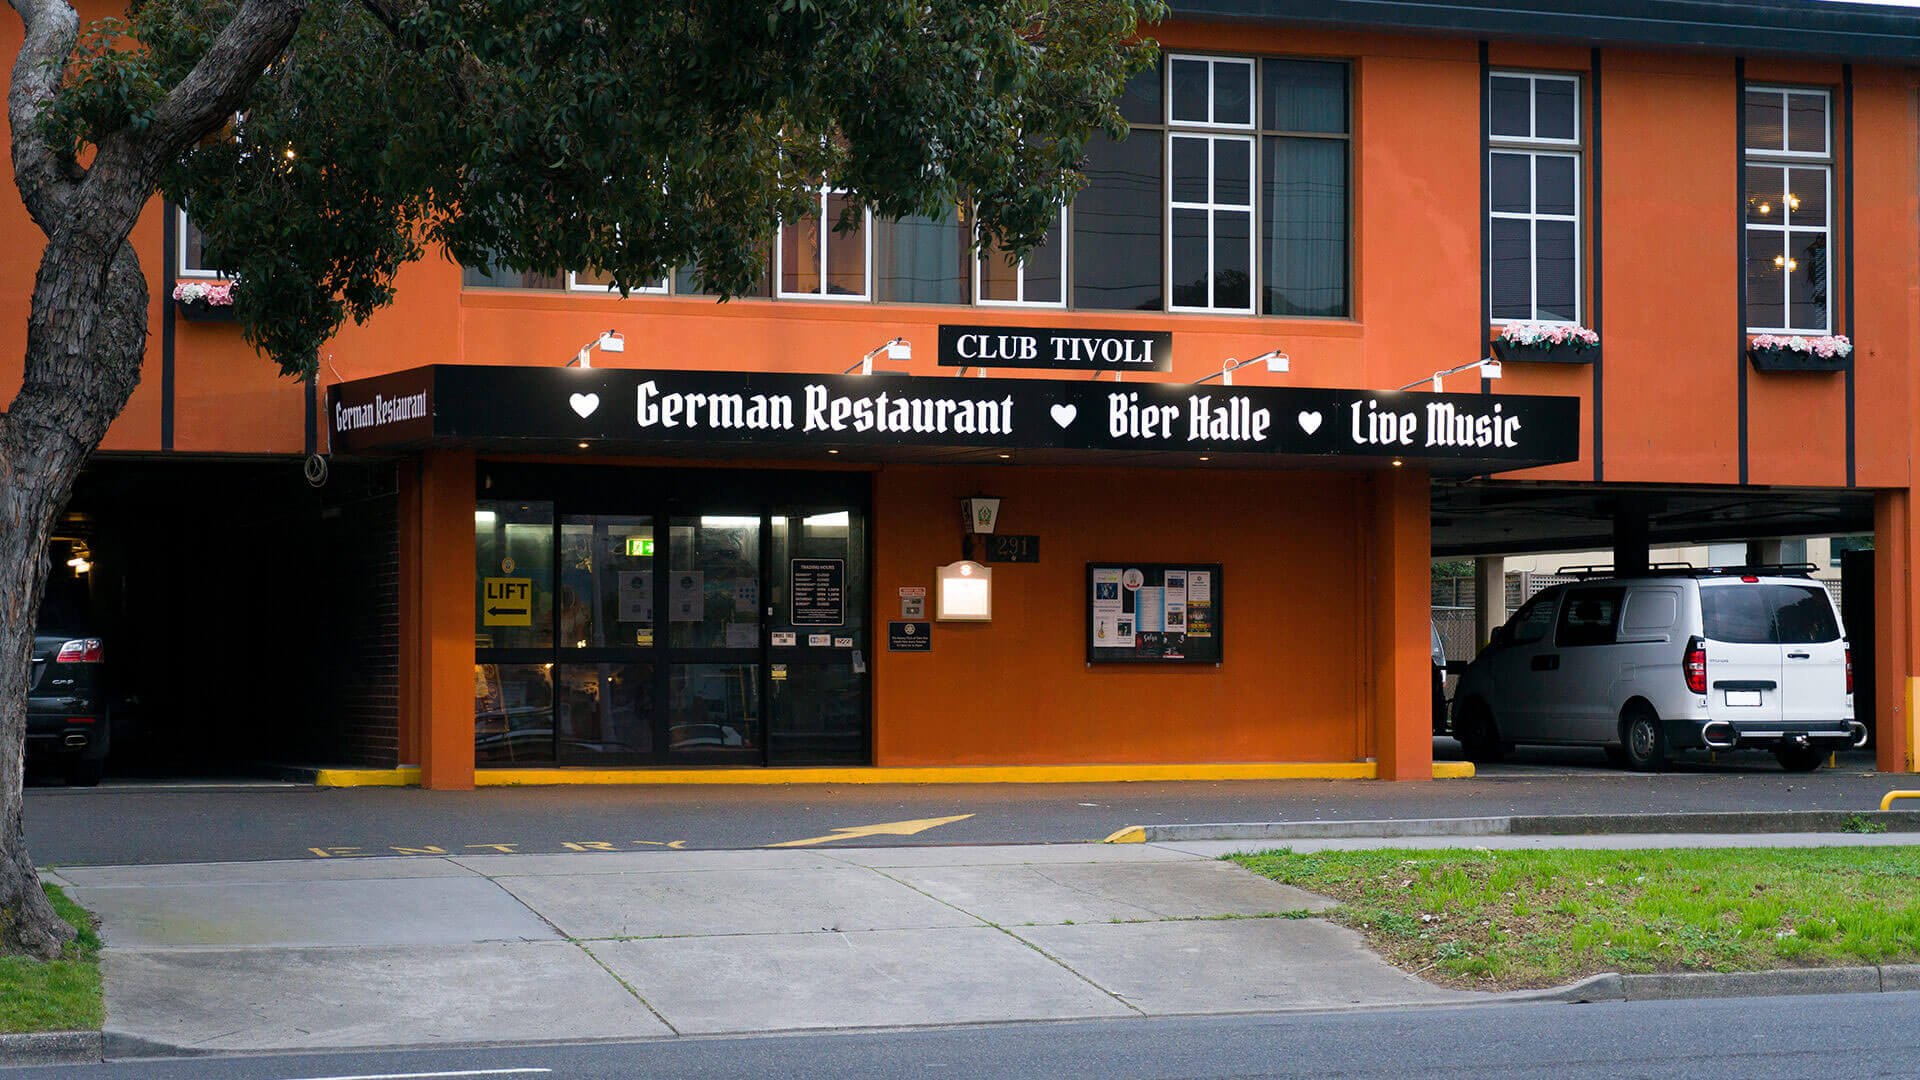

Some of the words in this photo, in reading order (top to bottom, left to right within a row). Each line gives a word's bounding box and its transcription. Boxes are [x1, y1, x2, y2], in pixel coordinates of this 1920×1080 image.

[956, 334, 1038, 360] CLUB
[1050, 337, 1154, 364] TIVOLI
[335, 397, 374, 433] German
[375, 388, 427, 427] Restaurant
[636, 380, 795, 429] German
[803, 383, 1014, 435] Restaurant
[1108, 392, 1180, 440] Bier
[1187, 396, 1271, 442] Halle
[1351, 402, 1418, 446] Live
[1425, 402, 1522, 448] Music
[487, 582, 529, 600] LIFT
[308, 840, 686, 857] ENTRY
